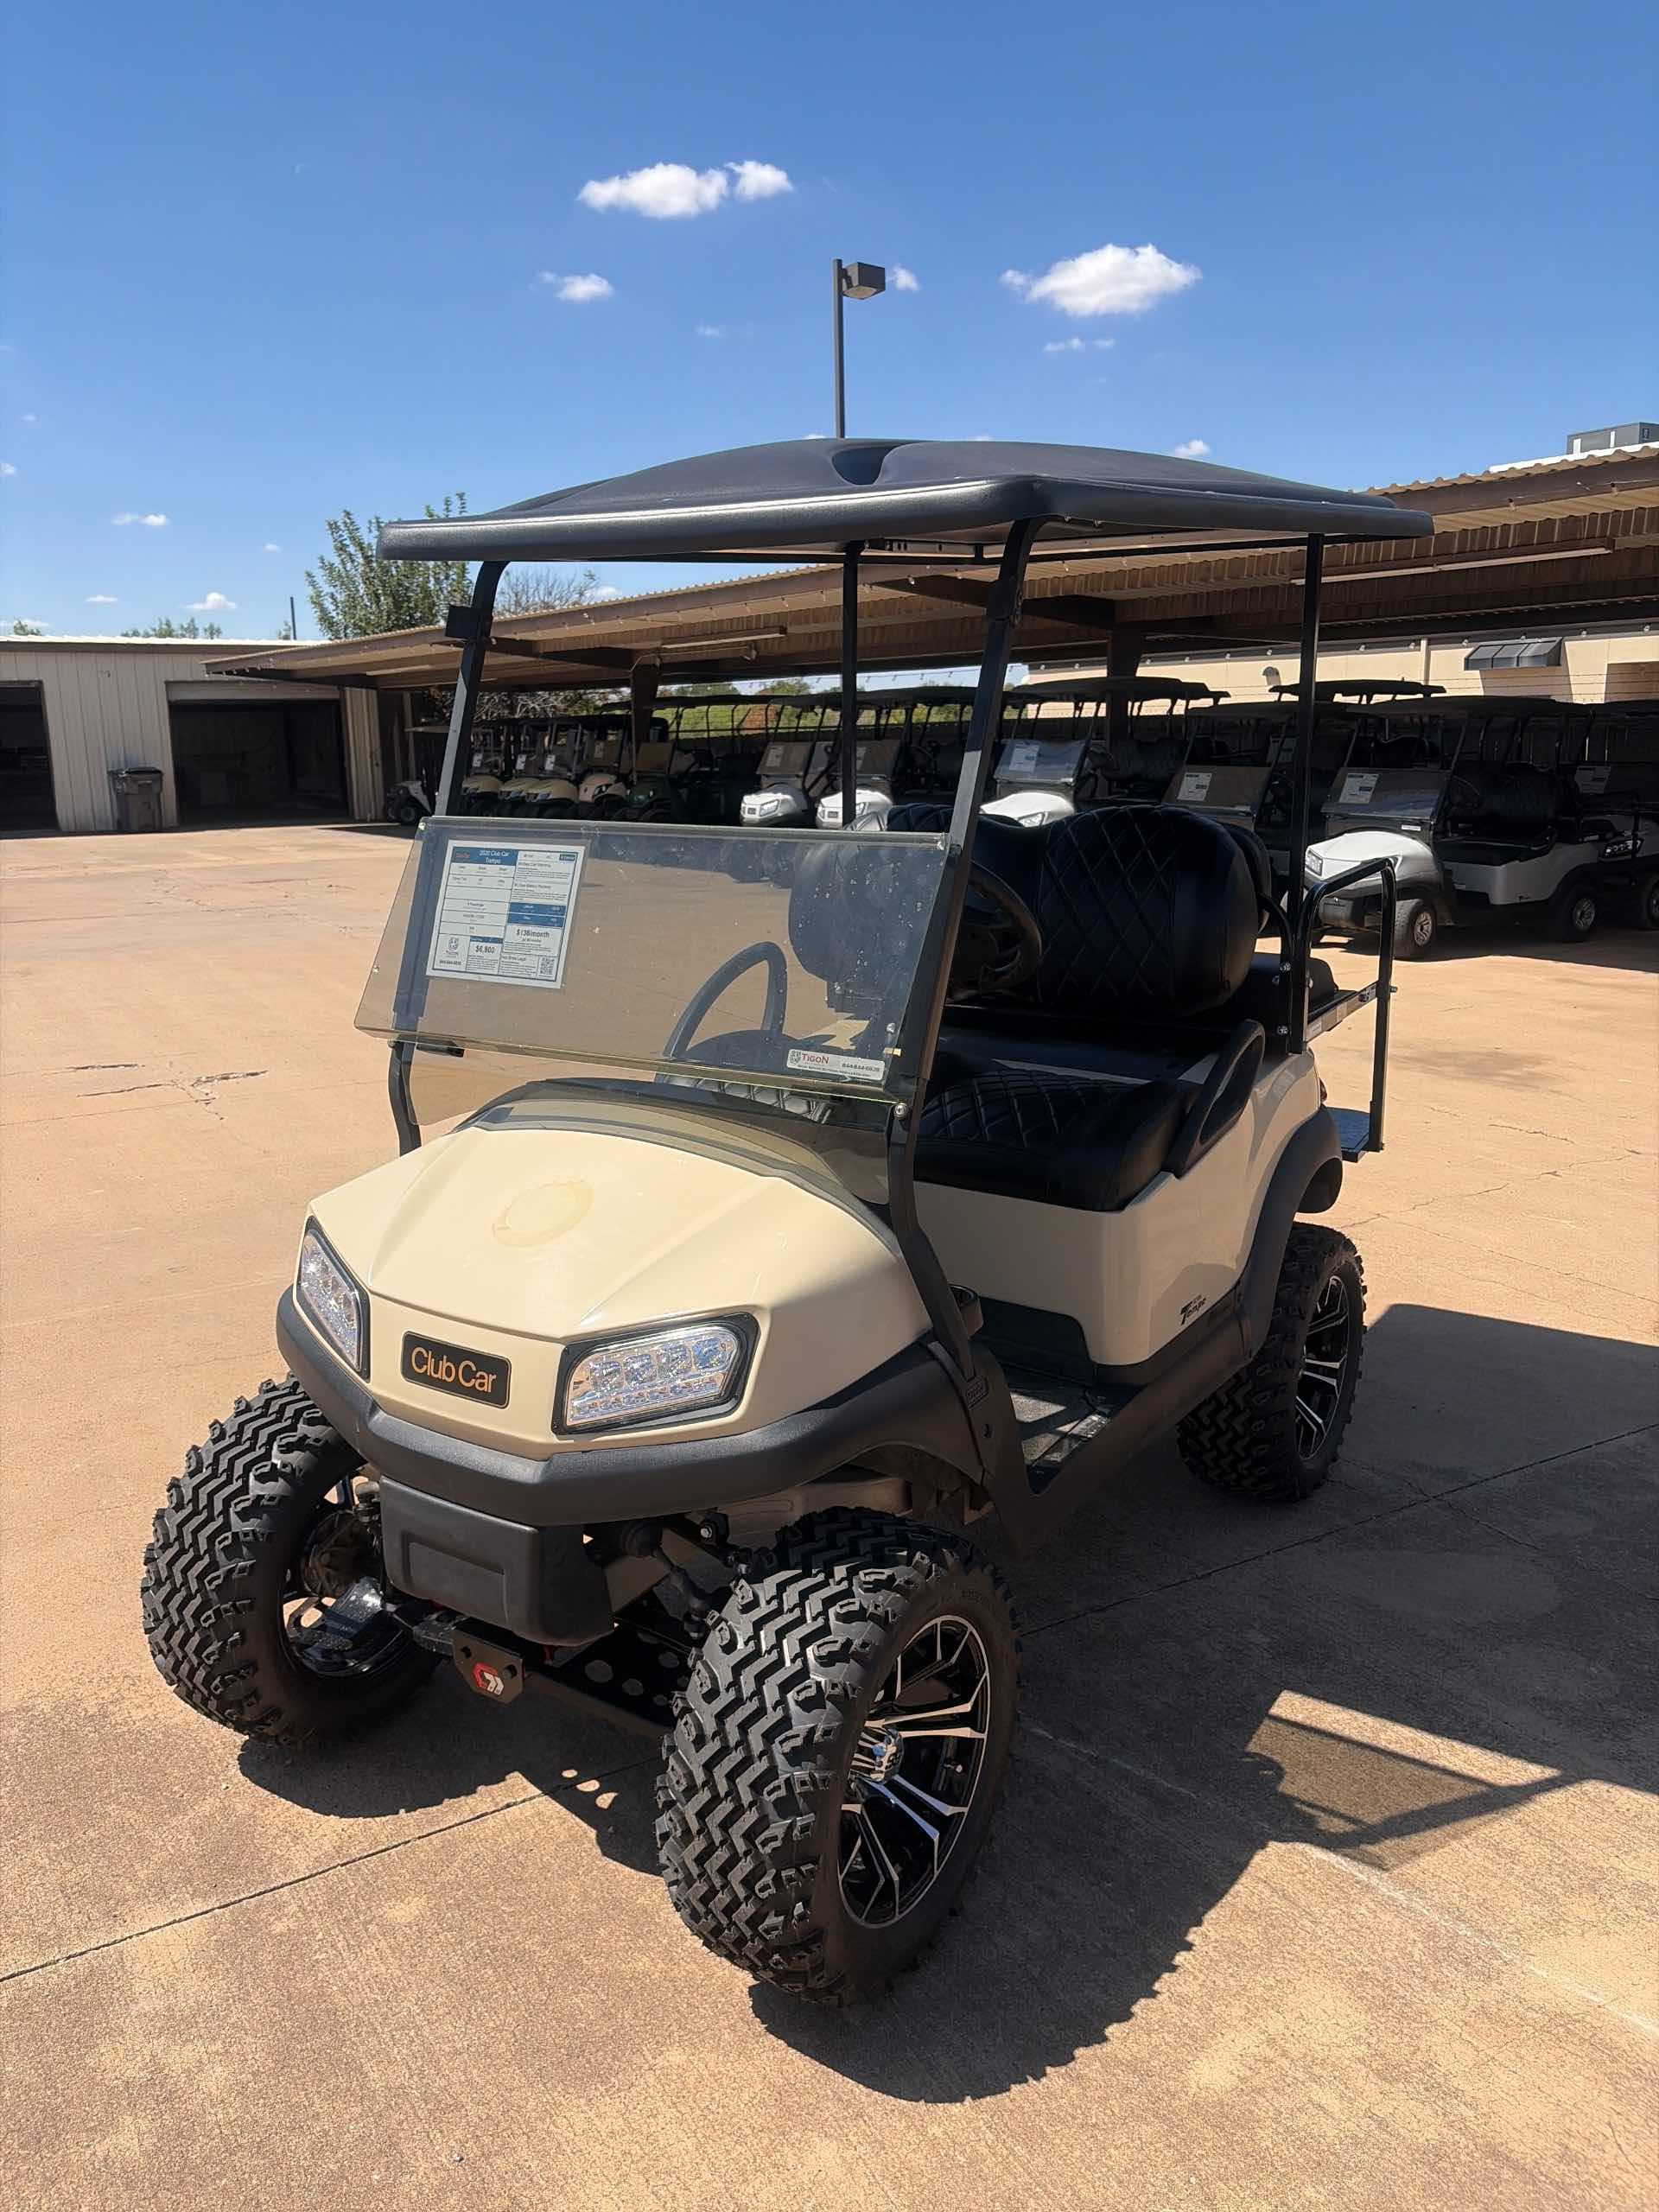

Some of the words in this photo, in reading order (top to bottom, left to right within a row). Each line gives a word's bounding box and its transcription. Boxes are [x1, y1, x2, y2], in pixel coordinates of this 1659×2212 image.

[802, 1053, 830, 1064] TIGON
[411, 1346, 455, 1383] Club
[458, 1360, 497, 1393] Car
